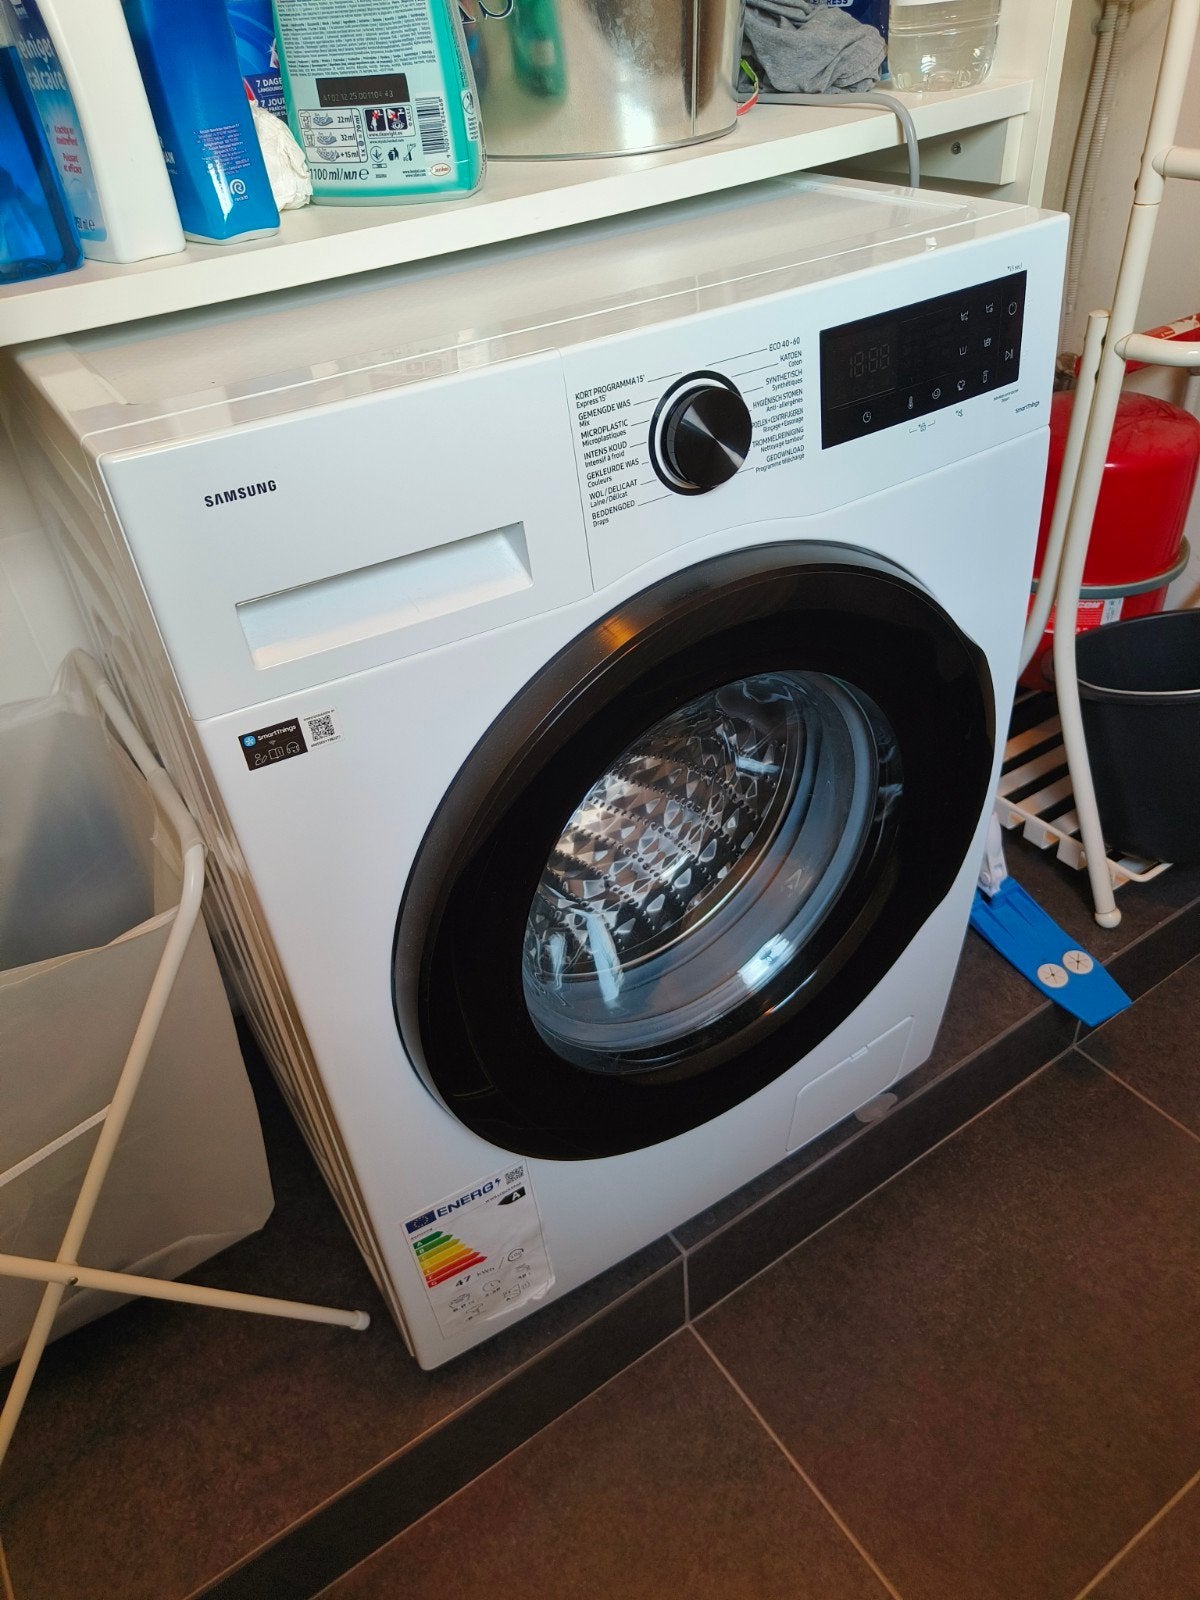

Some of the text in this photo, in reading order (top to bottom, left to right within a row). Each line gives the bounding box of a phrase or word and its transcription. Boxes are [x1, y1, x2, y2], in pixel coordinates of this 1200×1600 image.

[256, 78, 282, 88] 7 DAGE
[769, 342, 781, 352] ECO
[780, 350, 802, 362] KATOEN
[788, 359, 802, 368] Coton
[766, 368, 803, 386] SYNTHETISCH
[575, 390, 592, 400] KORT
[593, 377, 636, 395] PROGRAMMA
[576, 397, 599, 409] Express
[578, 399, 631, 421] GEMENGDE WAS
[580, 419, 628, 439] MICROPLASTIC
[582, 430, 627, 447] Microplastiques
[583, 441, 628, 460] INTENS KOUD
[585, 456, 606, 468] Intensif
[611, 450, 625, 460] froid
[766, 445, 805, 463] GEDOWNLOAD
[586, 458, 640, 480] GEKLEURDE WAS
[587, 476, 612, 488] Couleurs
[204, 480, 278, 508] SAMSUNG
[592, 500, 636, 520] BEDDENGOED
[593, 518, 609, 527] Draps
[258, 724, 296, 740] SmartThings
[437, 1181, 494, 1218] ENERG
[512, 1192, 521, 1200] A
[456, 1274, 472, 1287] 47
